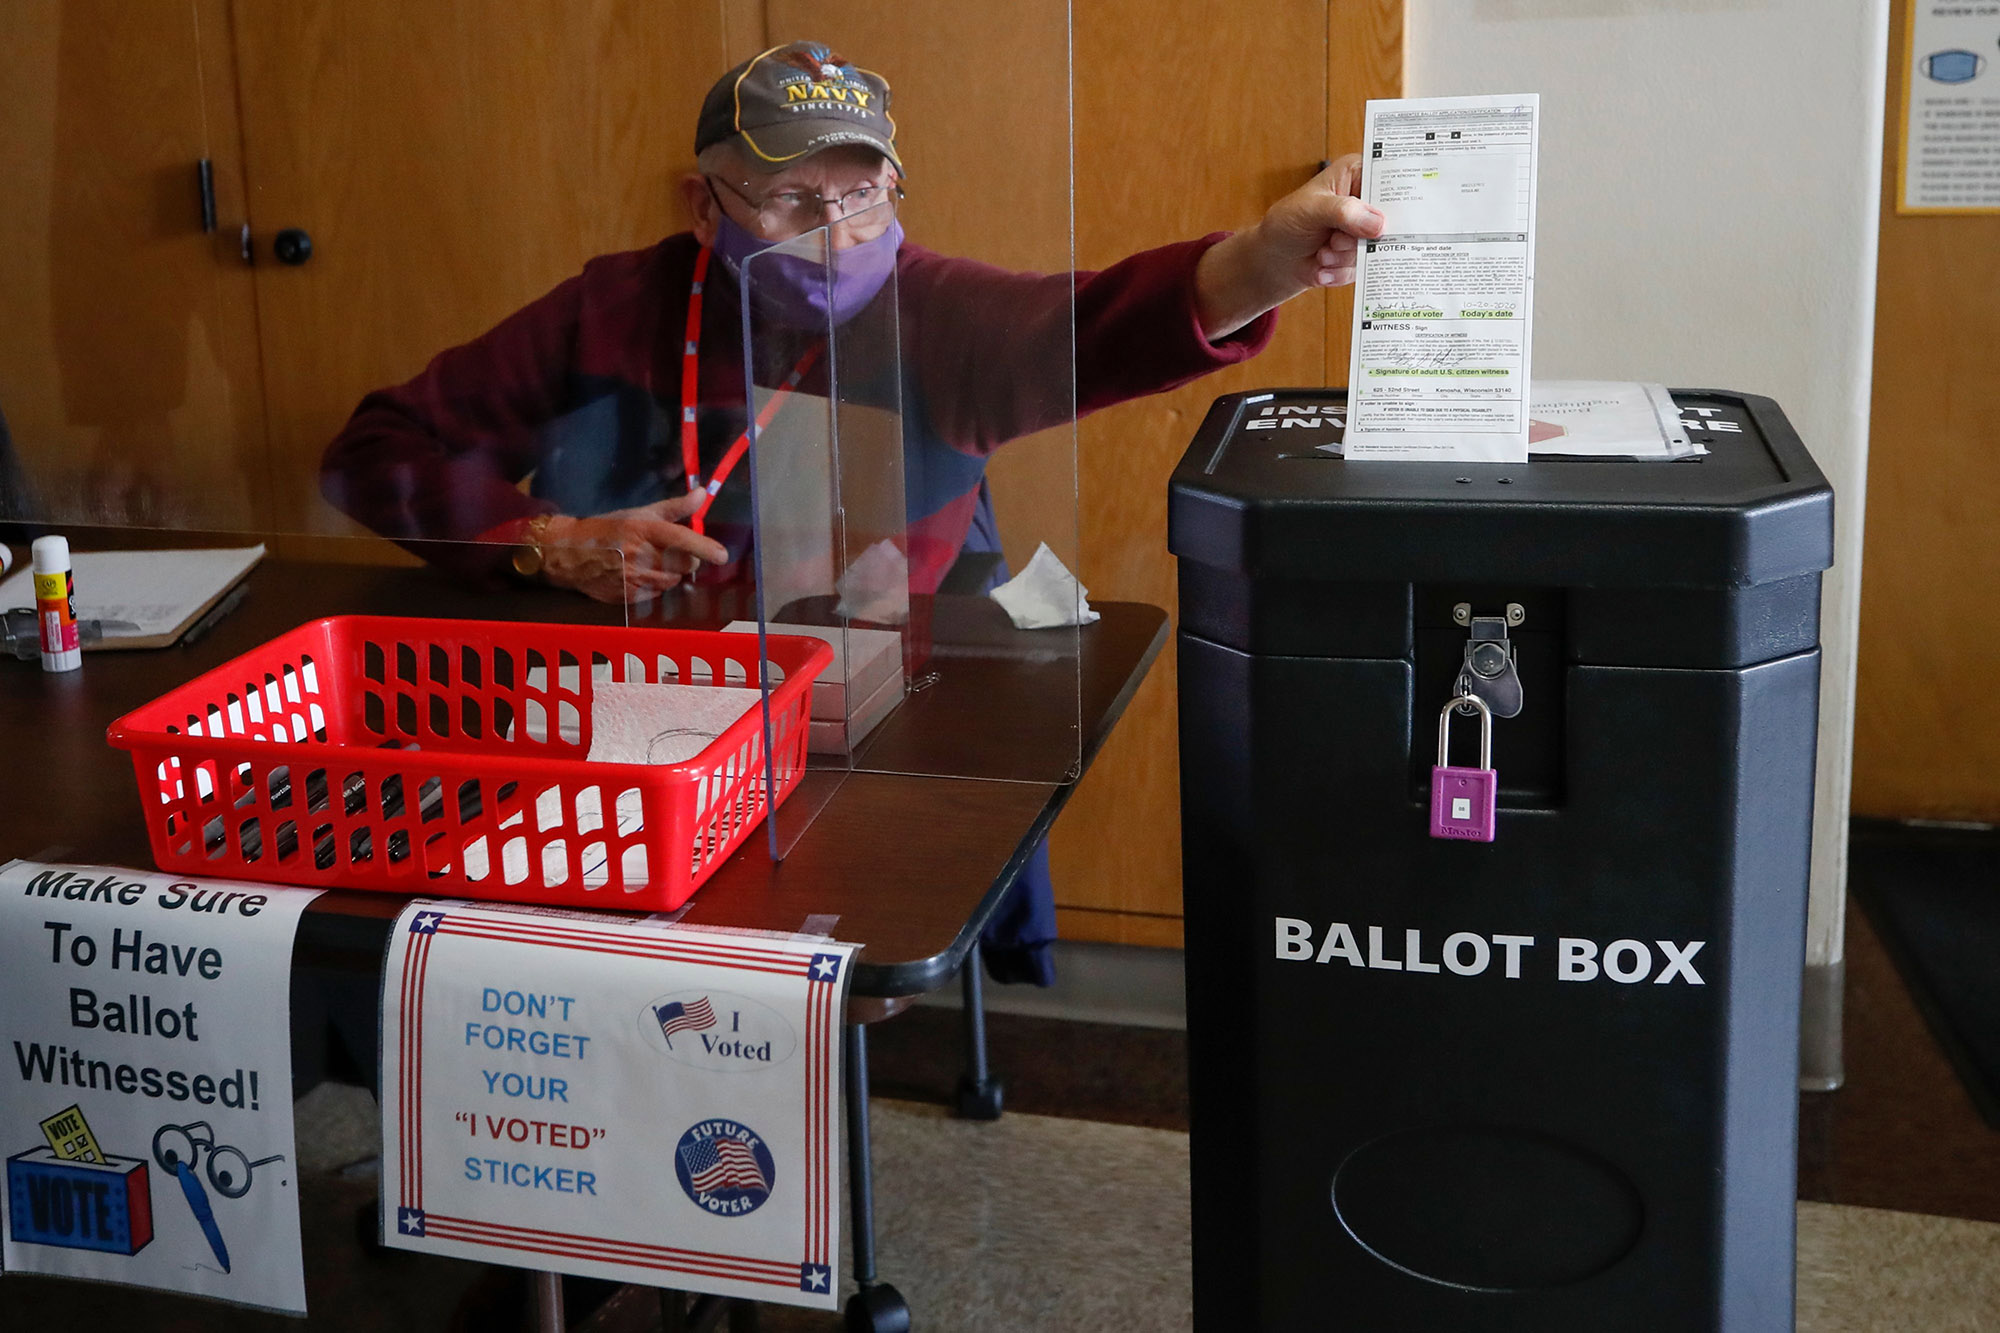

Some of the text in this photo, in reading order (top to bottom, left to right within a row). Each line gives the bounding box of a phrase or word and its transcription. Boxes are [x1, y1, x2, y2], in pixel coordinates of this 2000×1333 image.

[785, 84, 870, 107] NAVY
[792, 102, 867, 118] SINCE 1775
[1378, 244, 1406, 252] VOTER
[1372, 311, 1411, 320] Signature
[1461, 310, 1493, 319] Today's
[1463, 301, 1516, 310] 10-20-2020
[1372, 323, 1411, 331] WITNESS
[1375, 368, 1410, 377] Signature
[1436, 387, 1463, 395] Kenosha,
[1260, 405, 1347, 417] INS
[1440, 825, 1482, 838] Master
[24, 869, 268, 917] Make Sure
[44, 920, 223, 980] To Have
[1274, 916, 1707, 985] BALLOT BOX
[69, 987, 199, 1042] Ballot
[482, 987, 576, 1022] DON'T
[730, 1010, 741, 1033] I
[465, 1021, 591, 1060] FORGET
[700, 1033, 772, 1063] Voted
[13, 1040, 260, 1112] Witnessed!
[481, 1069, 569, 1104] YOUR
[47, 1112, 81, 1141] VOTE
[690, 1122, 761, 1149] FUTURE
[463, 1156, 598, 1196] STICKER
[25, 1174, 114, 1241] VOTE
[697, 1190, 754, 1214] VOTER
